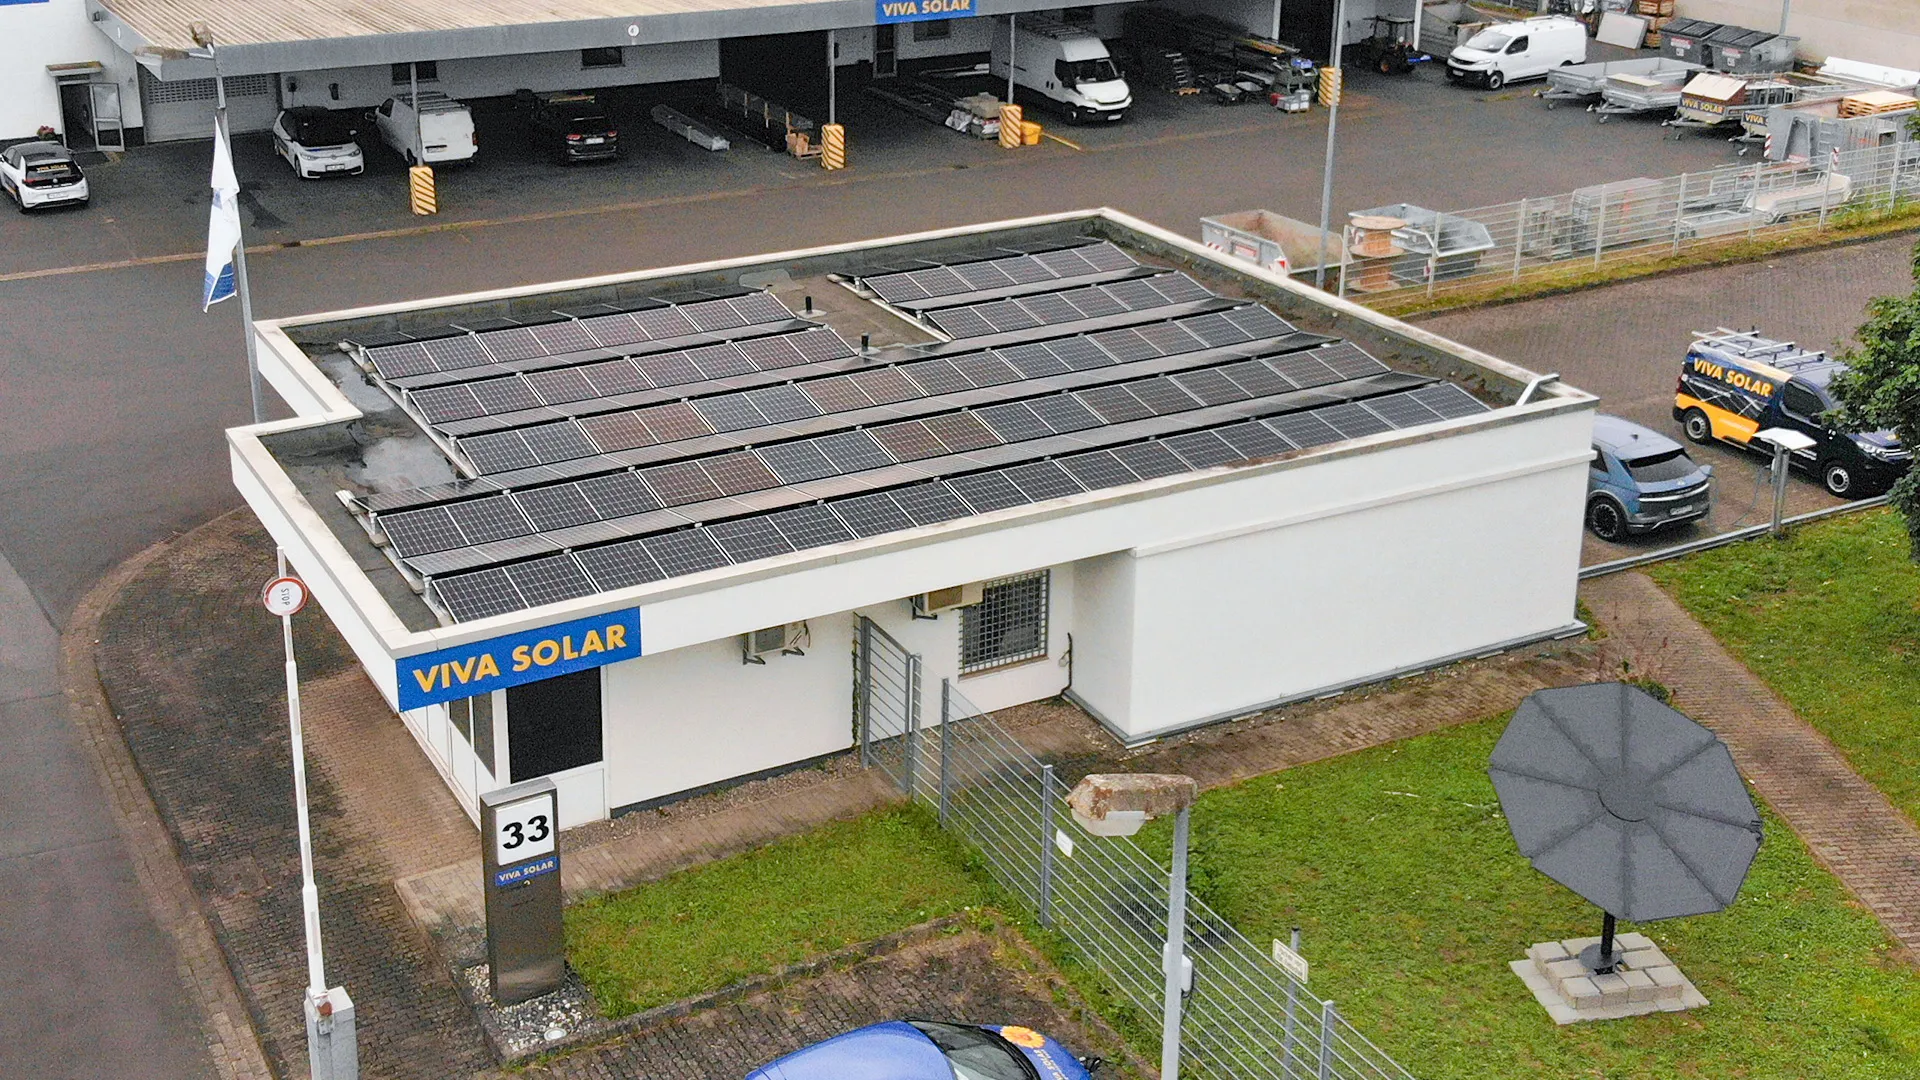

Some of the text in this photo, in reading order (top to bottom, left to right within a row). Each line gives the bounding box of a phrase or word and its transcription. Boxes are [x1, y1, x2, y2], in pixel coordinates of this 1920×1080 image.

[883, 0, 970, 17] VIVA SOLAR
[1681, 98, 1724, 114] VIVA SOLAR
[1745, 113, 1764, 124] VIVA
[1693, 357, 1774, 398] VIVA SOLAR
[280, 587, 291, 606] STOP
[412, 624, 628, 694] VIVA SOLAR
[502, 815, 550, 850] 33
[498, 860, 554, 882] VIVA SOLAR
